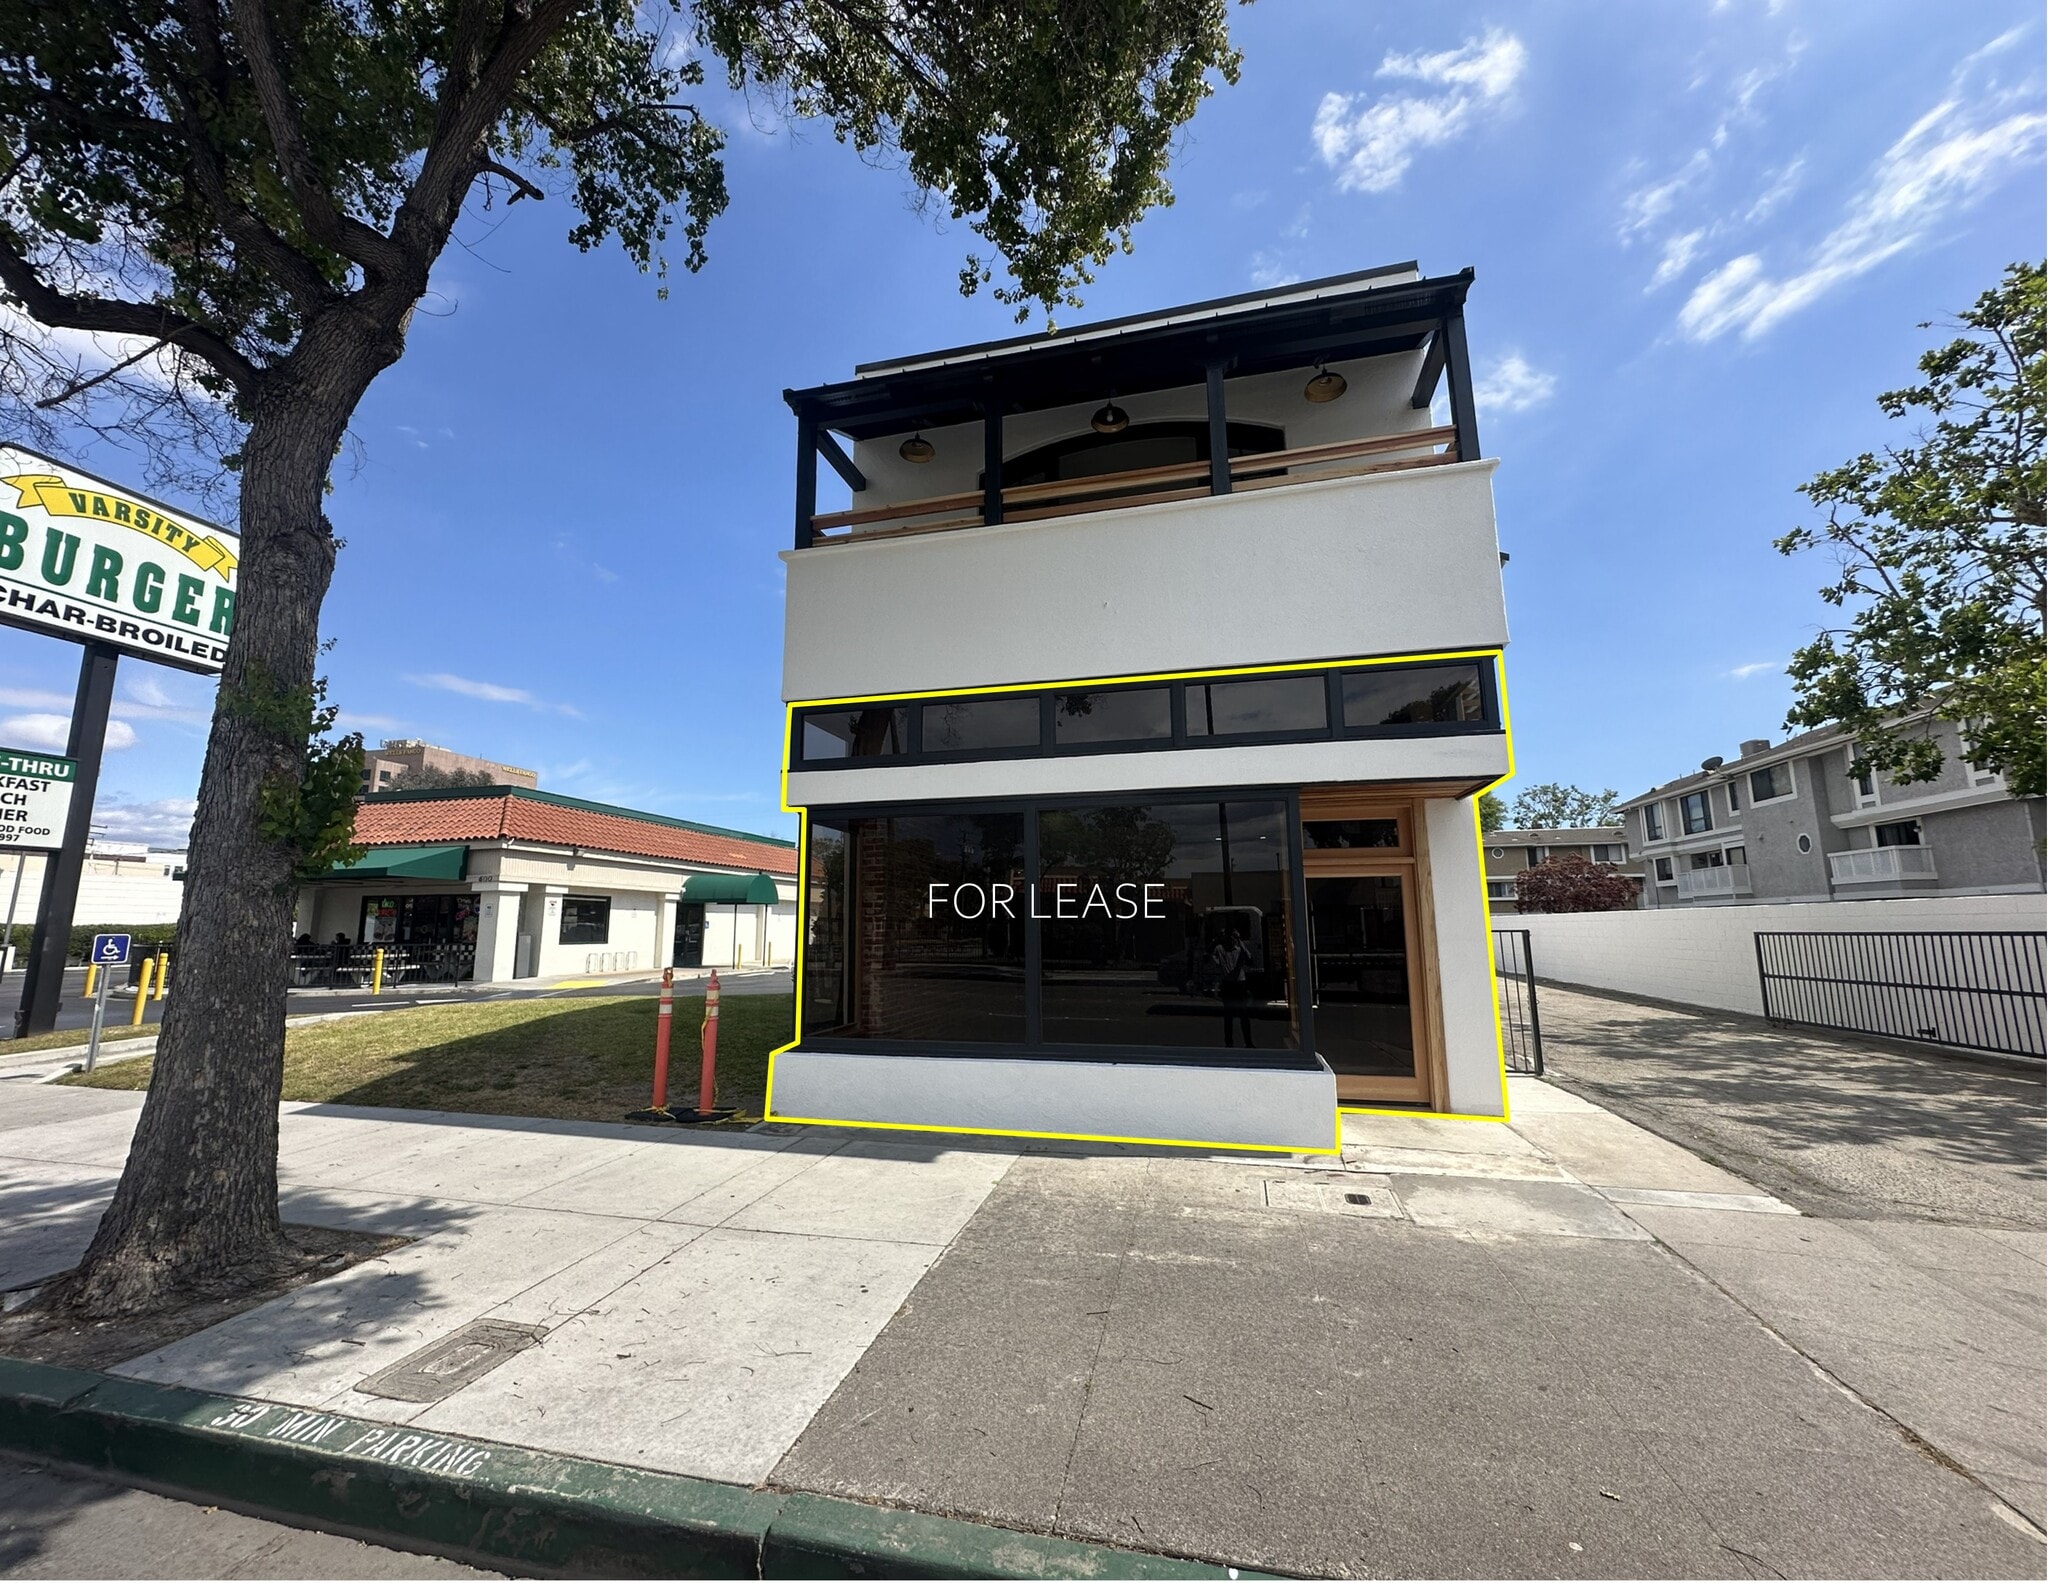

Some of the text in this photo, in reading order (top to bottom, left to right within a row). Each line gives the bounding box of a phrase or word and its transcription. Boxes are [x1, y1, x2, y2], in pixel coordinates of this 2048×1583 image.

[68, 491, 201, 554] VARSITY
[0, 511, 236, 637] BURGER
[18, 826, 51, 836] FOOD
[267, 1411, 347, 1443] MIN
[343, 1428, 491, 1476] PARKING
